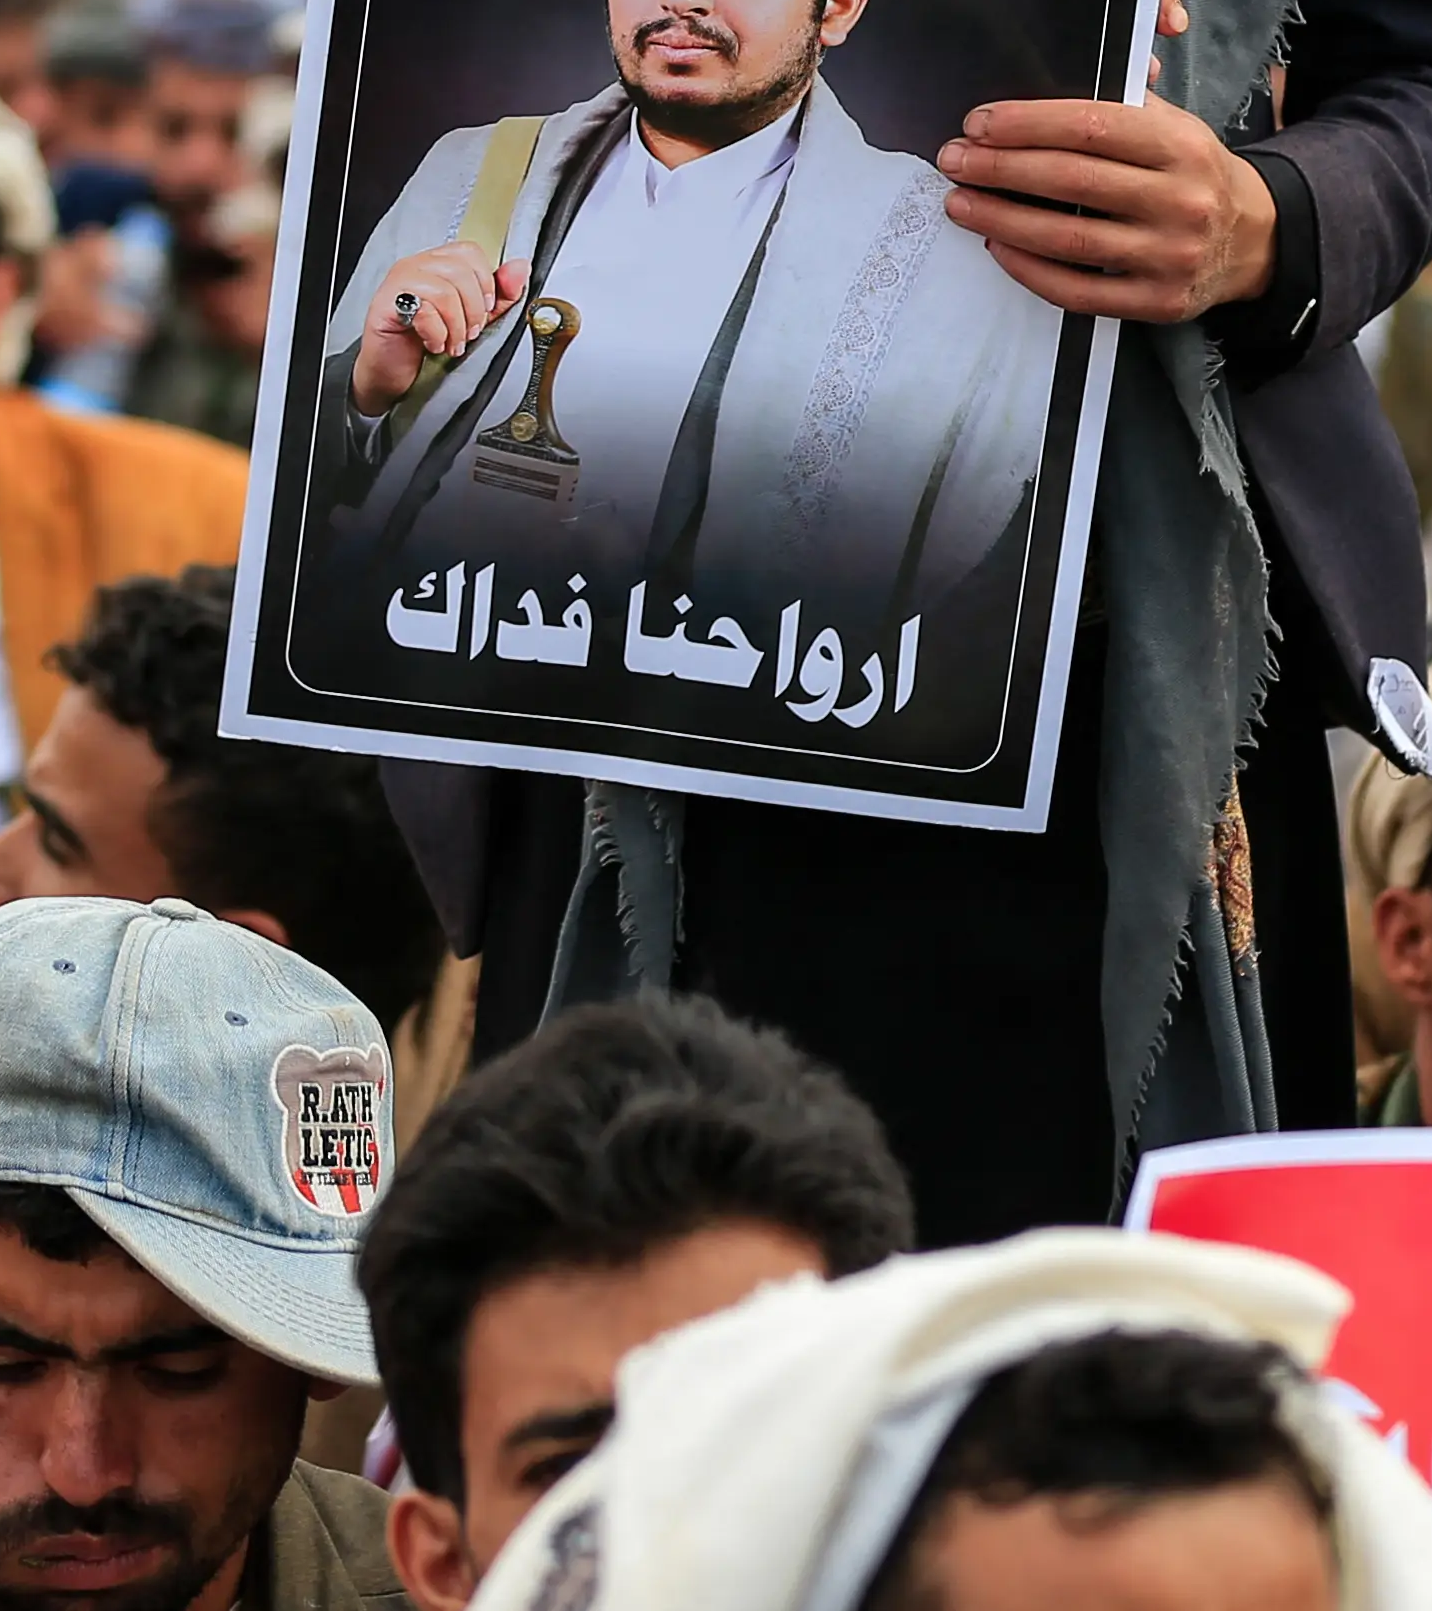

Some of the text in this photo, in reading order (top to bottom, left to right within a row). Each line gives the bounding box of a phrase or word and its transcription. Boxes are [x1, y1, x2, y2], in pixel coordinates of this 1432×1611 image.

[385, 559, 594, 668] فداك
[300, 1084, 374, 1124] R.ATH
[301, 1127, 375, 1168] LETIC
